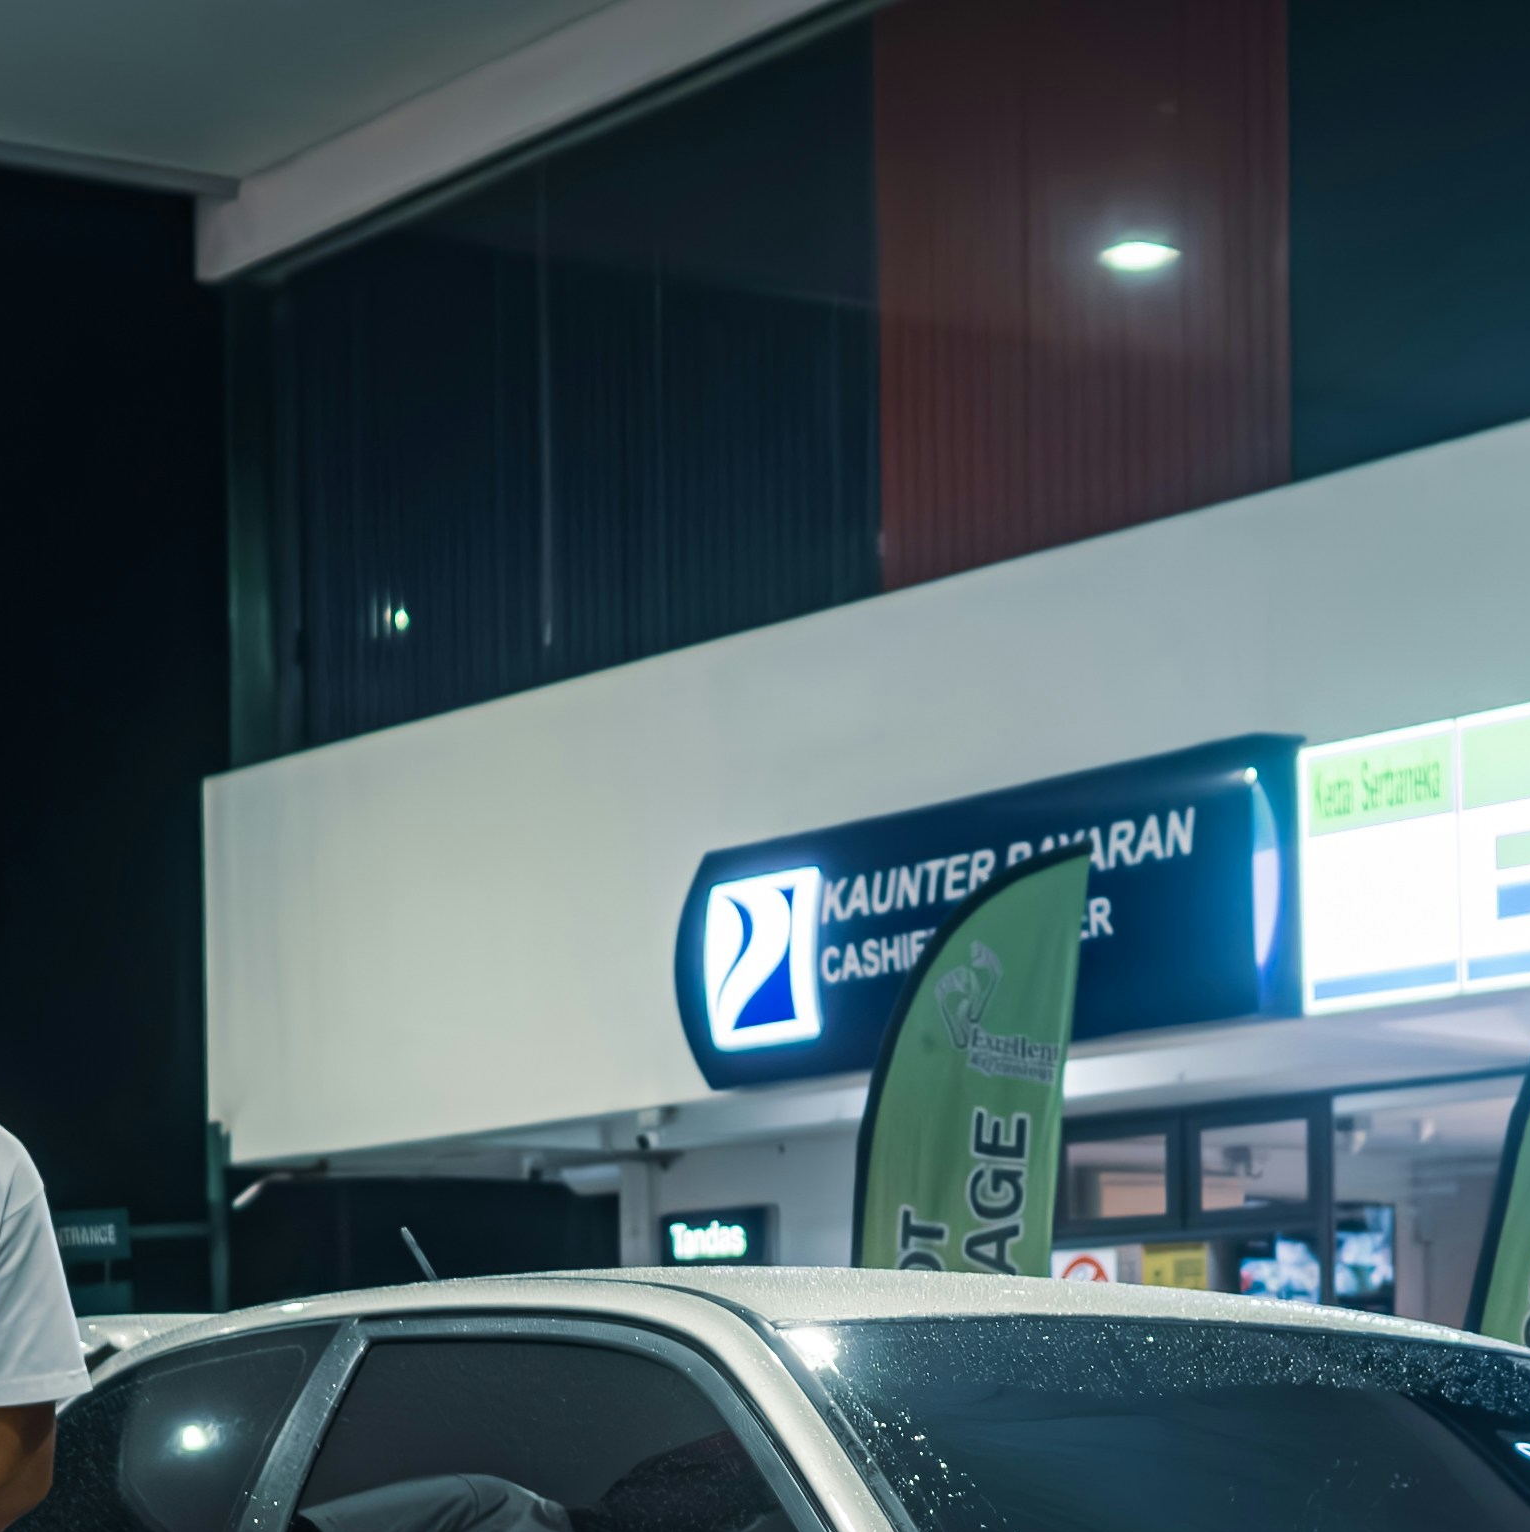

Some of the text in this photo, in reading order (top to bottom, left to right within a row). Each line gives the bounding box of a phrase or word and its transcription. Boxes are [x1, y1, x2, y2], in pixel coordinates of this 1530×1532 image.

[821, 848, 996, 924] KAUNTER
[1006, 806, 1196, 872] ARAN
[820, 927, 937, 984] CASHIE
[56, 1223, 117, 1247] NTRANCE
[669, 1219, 747, 1260] Tandas
